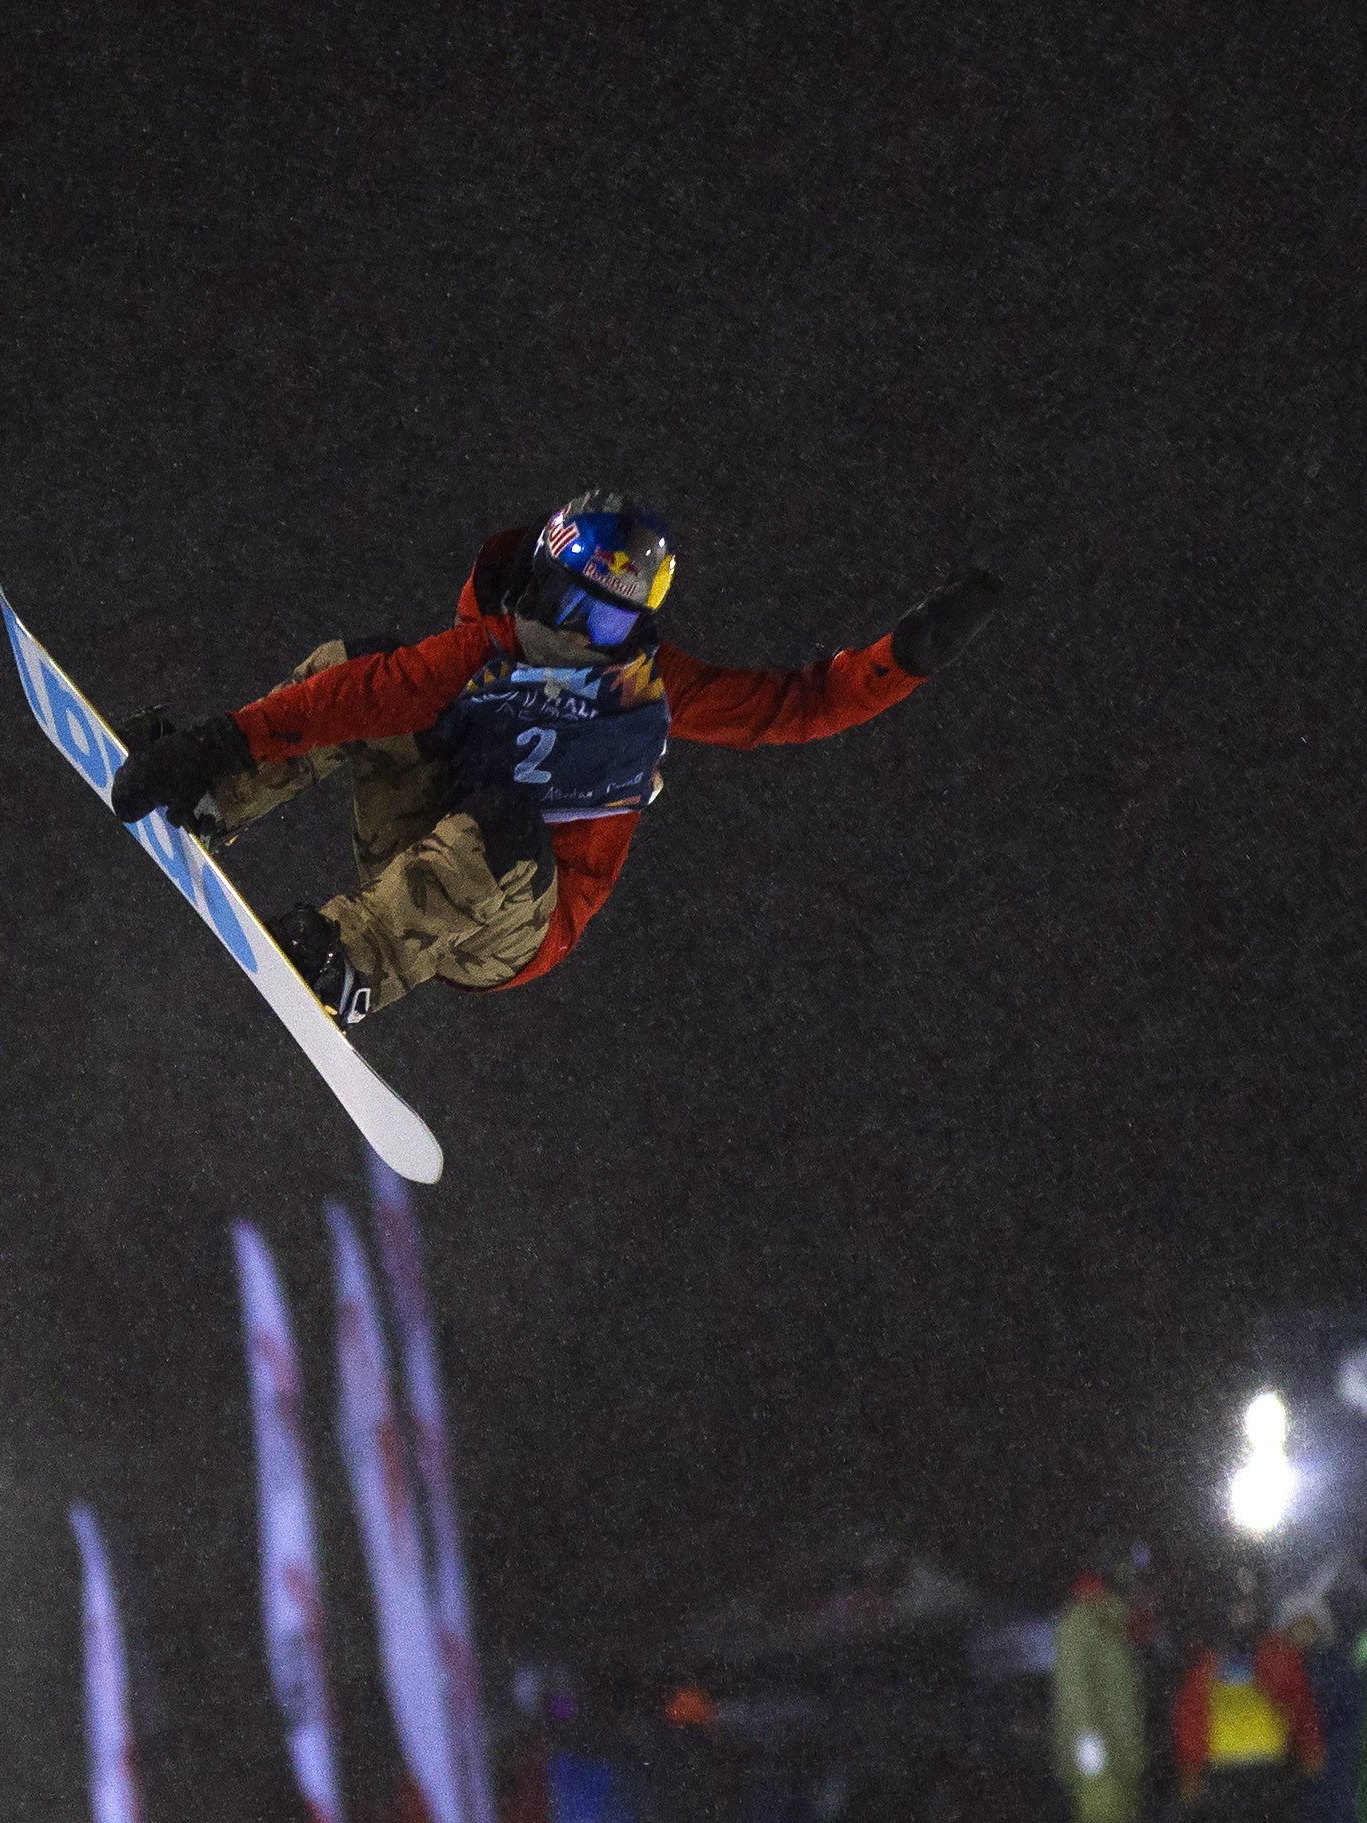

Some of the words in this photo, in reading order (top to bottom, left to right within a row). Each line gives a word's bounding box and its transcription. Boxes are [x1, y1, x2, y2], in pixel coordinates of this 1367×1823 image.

[583, 562, 612, 587] Red
[609, 576, 639, 598] Bull
[513, 726, 557, 784] 2
